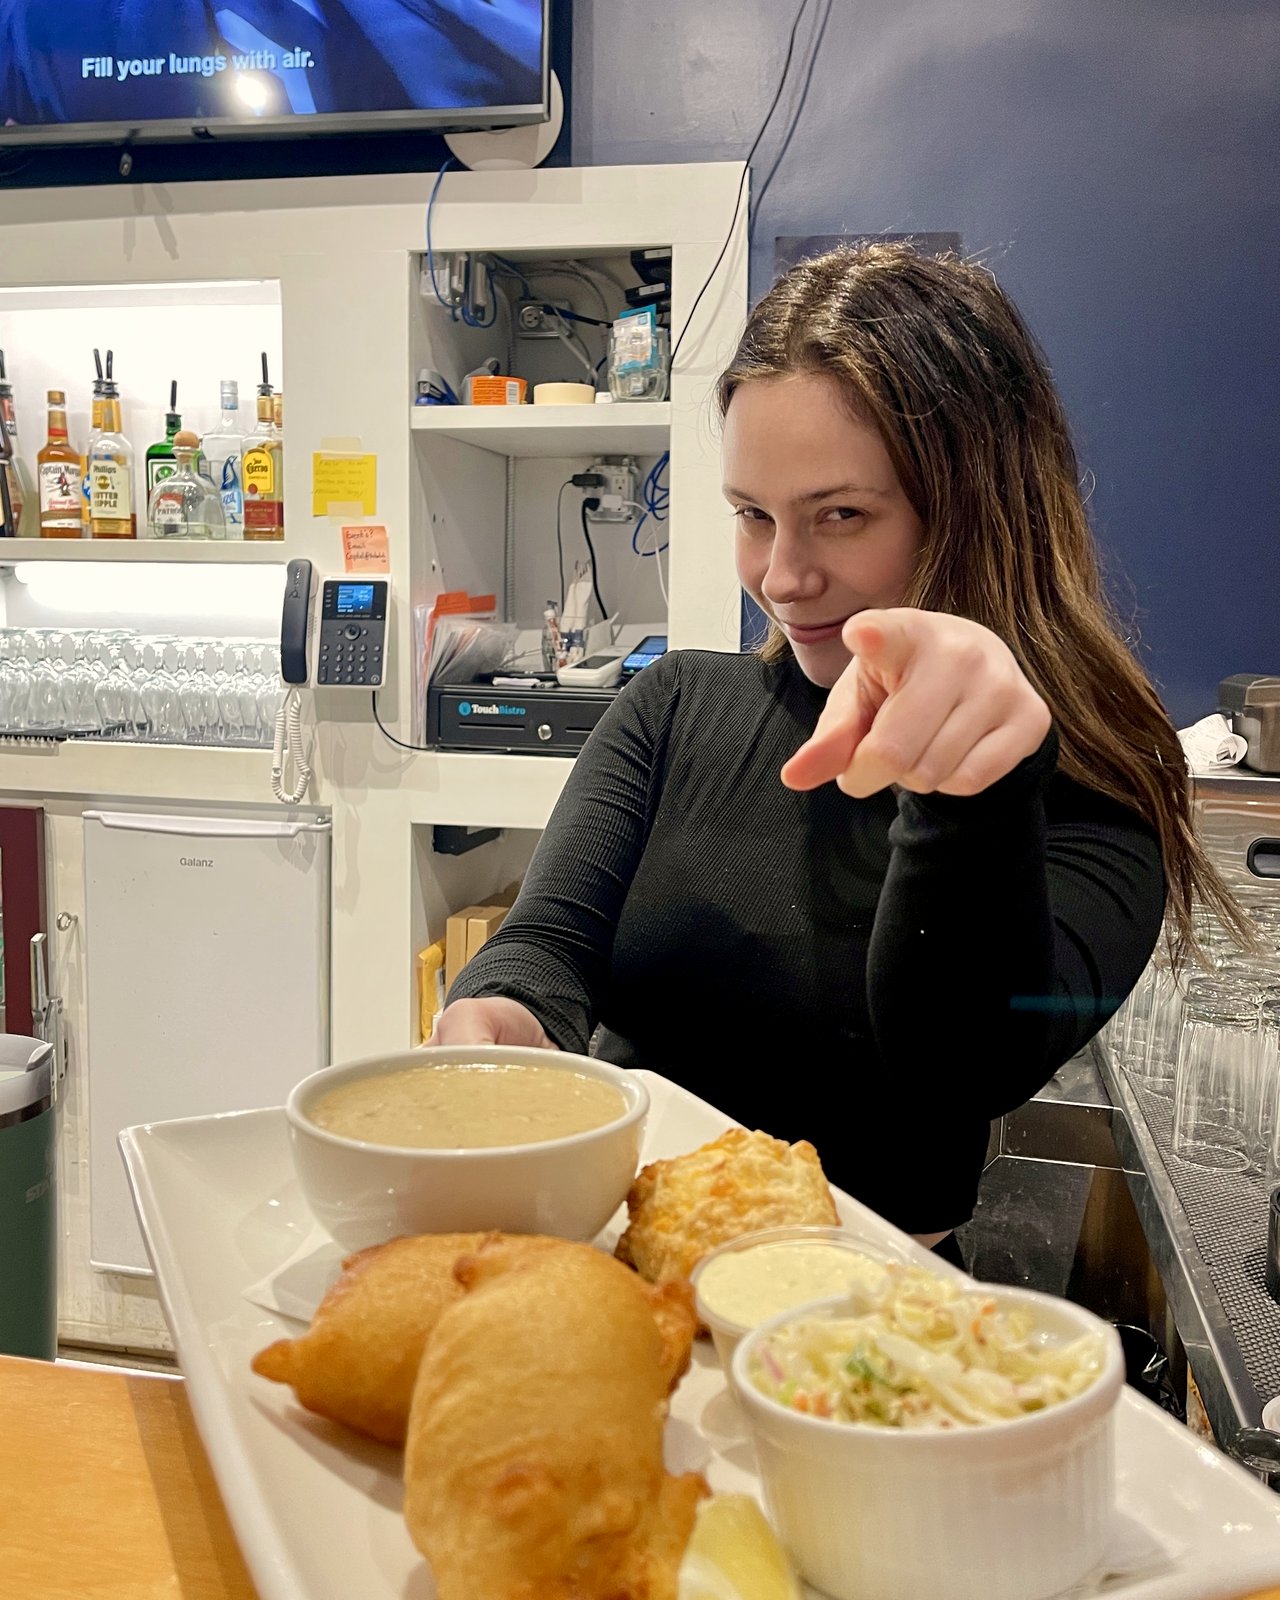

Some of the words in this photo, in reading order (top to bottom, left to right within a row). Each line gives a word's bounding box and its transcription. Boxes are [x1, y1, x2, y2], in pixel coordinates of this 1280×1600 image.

[81, 57, 113, 78] Fill
[117, 54, 164, 81] your
[168, 51, 227, 78] lungs
[231, 48, 276, 71] with
[282, 47, 315, 69] air.
[93, 465, 117, 474] Phillips
[471, 703, 526, 715] TouchBistro
[179, 857, 214, 868] Galanz
